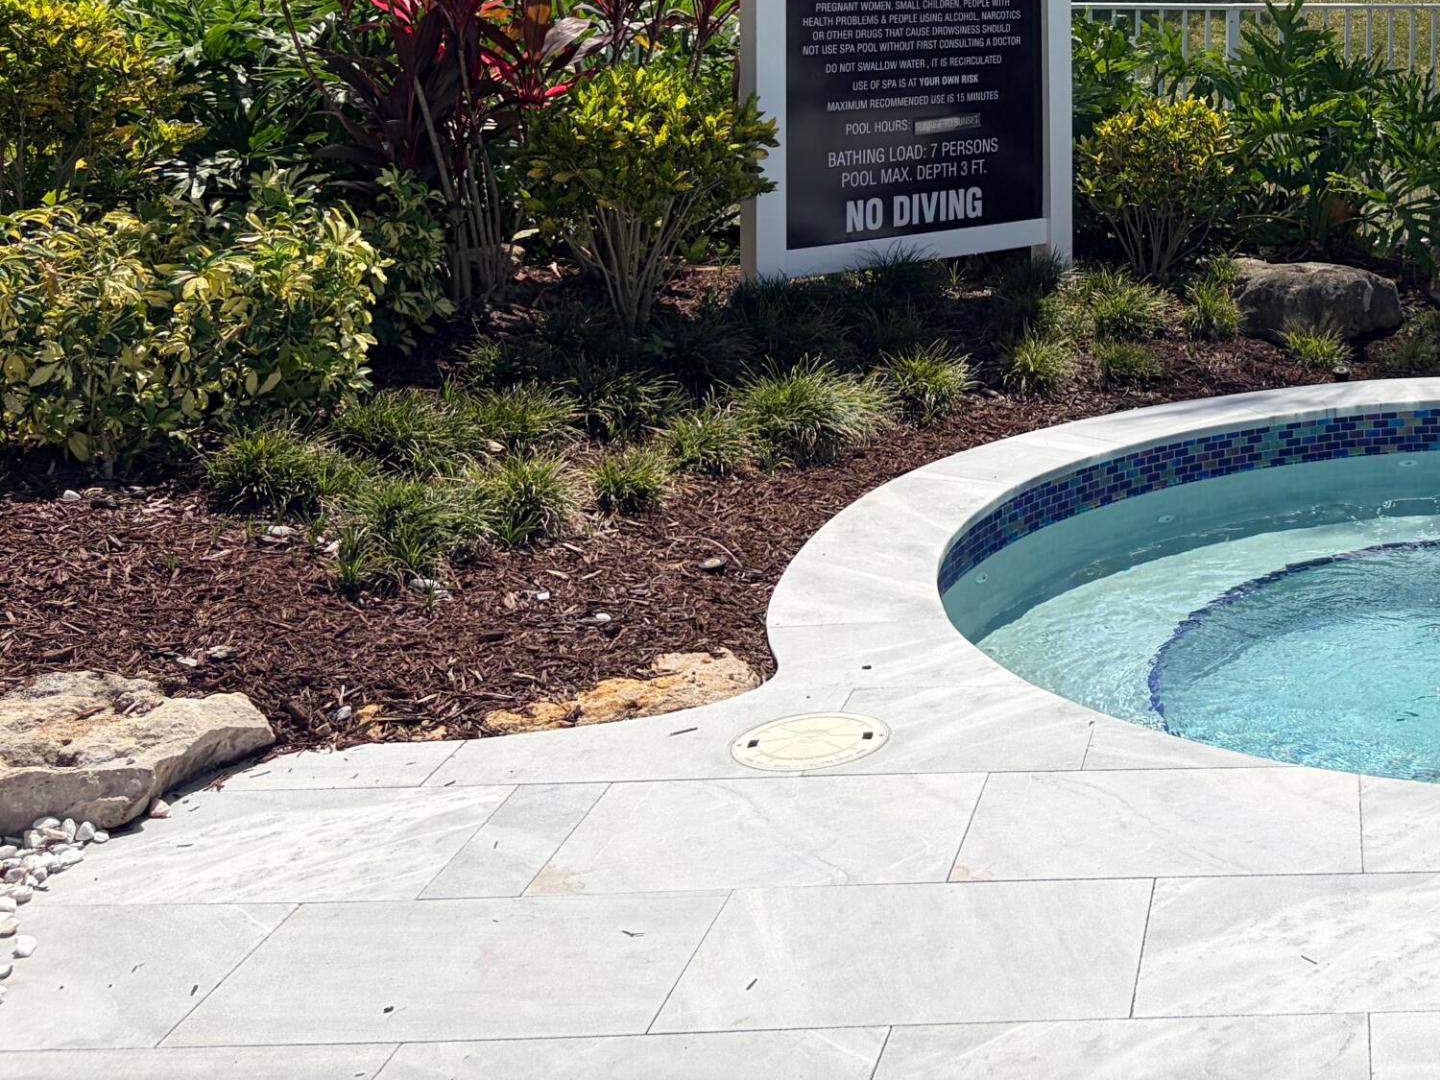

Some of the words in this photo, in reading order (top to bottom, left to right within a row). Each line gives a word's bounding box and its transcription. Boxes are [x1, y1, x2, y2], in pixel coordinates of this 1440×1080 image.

[816, 2, 858, 12] PREGNANT
[895, 1, 920, 10] SMALL
[964, 0, 990, 8] PEOPLE
[803, 17, 833, 26] HEALTH
[836, 15, 878, 25] PROBLEMS
[889, 14, 917, 24] PEOPLE
[920, 13, 942, 22] USING
[982, 10, 1021, 20] NARCOTICS
[812, 31, 824, 40] OR
[826, 30, 853, 40] OTHER
[855, 29, 882, 39] DRUGS
[885, 28, 903, 37] THAT
[906, 27, 930, 37] CAUSE
[932, 25, 980, 36] DROWSINESS
[982, 24, 1010, 33] SHOULD
[803, 45, 819, 55] NOT
[822, 45, 837, 54] USE
[840, 44, 855, 53] SPA
[857, 43, 878, 53] POOL
[880, 42, 914, 51] WITHOUT
[916, 40, 937, 49] FIRST
[939, 38, 984, 49] CONSULTING
[986, 38, 991, 46] A
[993, 36, 1021, 46] DOCTOR
[826, 64, 837, 73] DO
[840, 63, 855, 72] NOT
[857, 62, 897, 72] SWALLOW
[931, 58, 938, 67] IT
[940, 58, 947, 66] IS
[950, 55, 1002, 66] RECIRCULATED
[852, 81, 868, 90] USE
[870, 80, 880, 89] OF
[882, 80, 897, 89] SPA
[899, 79, 906, 88] IS
[908, 78, 917, 87] AT
[919, 77, 940, 86] YOUR
[942, 76, 959, 85] OWN
[962, 74, 978, 84] RISK
[827, 100, 867, 111] MAXIMUM
[870, 96, 928, 108] RECOMMENDED
[931, 94, 945, 104] USE
[947, 94, 954, 103] IS
[957, 93, 964, 102] 15
[967, 91, 999, 101] MINUTES
[846, 123, 871, 135] POOL
[874, 120, 910, 133] HOURS:
[828, 148, 884, 168] BATHING
[889, 145, 926, 161] LOAD:
[931, 144, 937, 157] 7
[942, 137, 998, 156] PERSONS
[842, 171, 876, 187] POOL
[881, 168, 912, 184] MAX.
[917, 163, 956, 180] DEPTH
[961, 162, 967, 176] 3
[971, 159, 987, 174] FT.
[846, 198, 883, 233] NO
[893, 187, 982, 227] DIVING
